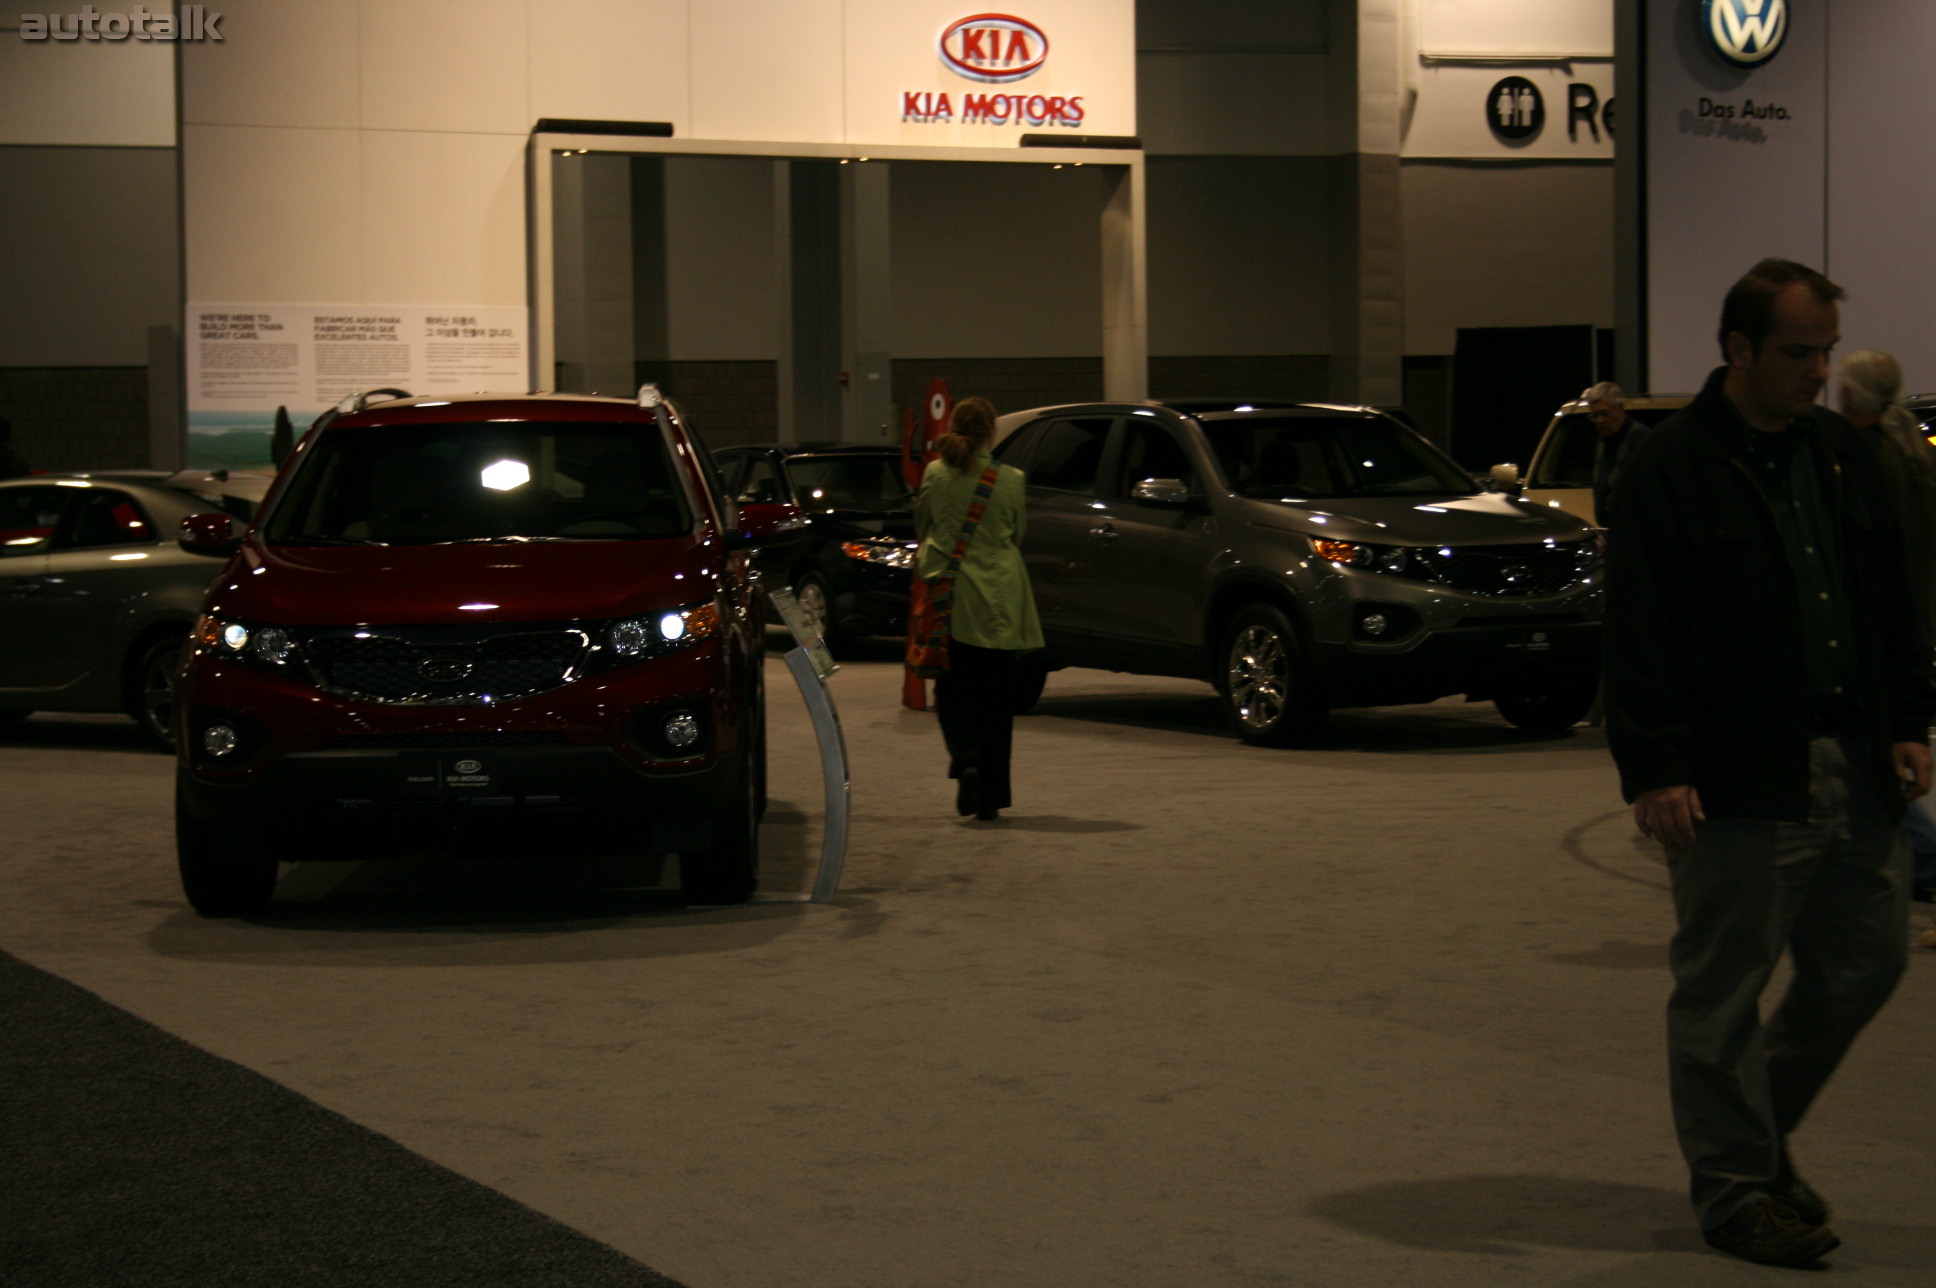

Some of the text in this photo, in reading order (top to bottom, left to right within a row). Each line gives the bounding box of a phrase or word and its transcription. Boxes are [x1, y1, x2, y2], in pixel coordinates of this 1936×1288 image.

[961, 28, 1031, 61] KIA
[903, 91, 1085, 121] KIA MOTORS
[1699, 98, 1792, 120] Das Auto.
[230, 314, 255, 322] HERE
[257, 314, 271, 322] TO
